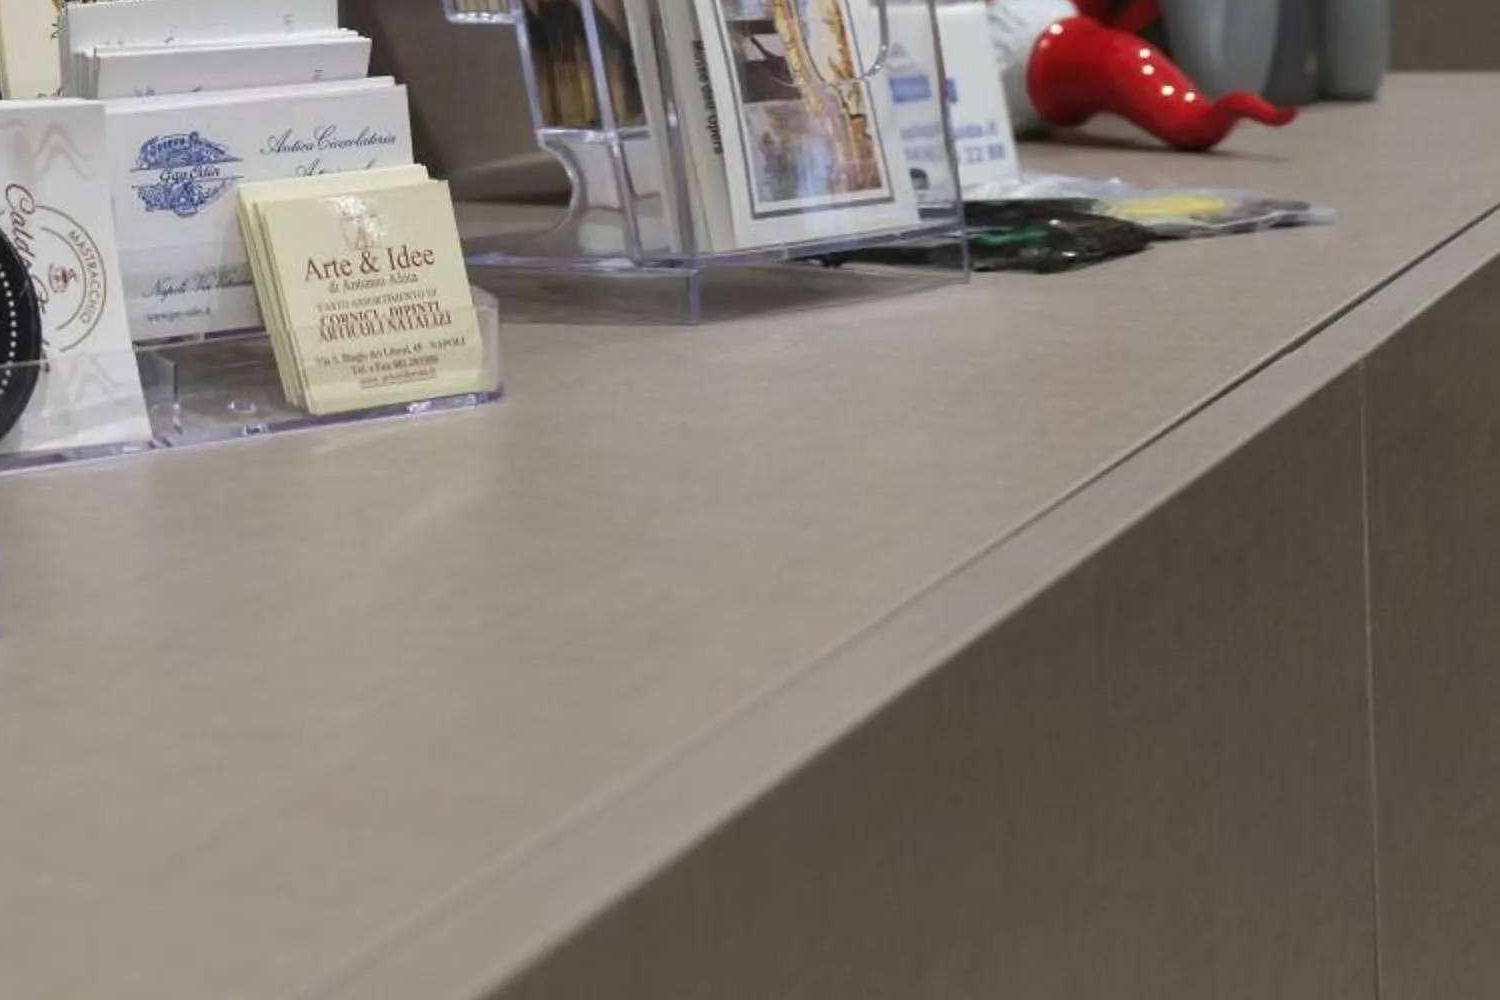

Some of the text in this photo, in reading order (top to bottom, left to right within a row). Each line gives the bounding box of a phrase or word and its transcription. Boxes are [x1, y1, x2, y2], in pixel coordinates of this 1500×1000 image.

[305, 244, 436, 283] Arte & Idee
